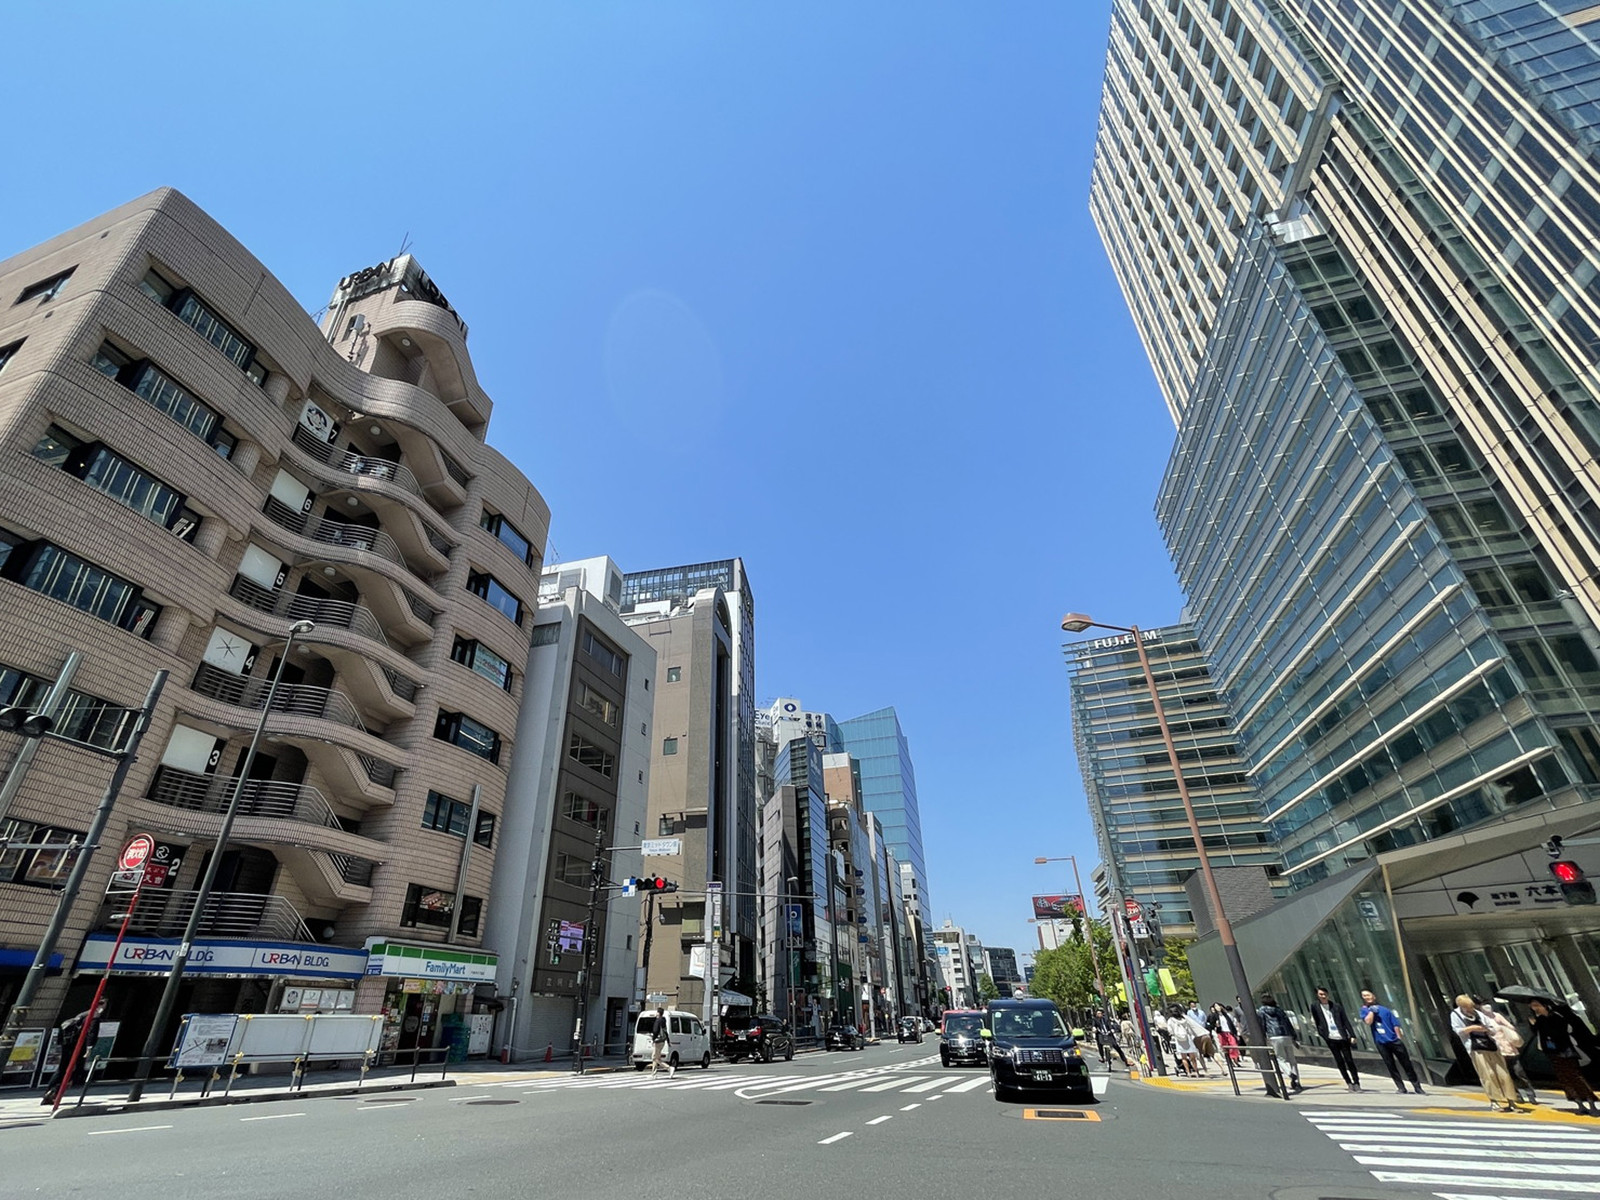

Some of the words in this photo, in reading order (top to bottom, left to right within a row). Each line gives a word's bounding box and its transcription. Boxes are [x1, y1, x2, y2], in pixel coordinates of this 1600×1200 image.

[338, 257, 395, 290] URBAN
[330, 428, 338, 440] 7
[304, 499, 312, 511] 6
[276, 572, 285, 585] 5
[1094, 630, 1158, 649] FUJIFIM
[245, 656, 255, 669] 4
[209, 750, 220, 766] 3
[168, 858, 181, 876] 2
[124, 947, 175, 961] URBAN
[261, 952, 301, 966] URBAN
[425, 961, 466, 976] FamilyMart
